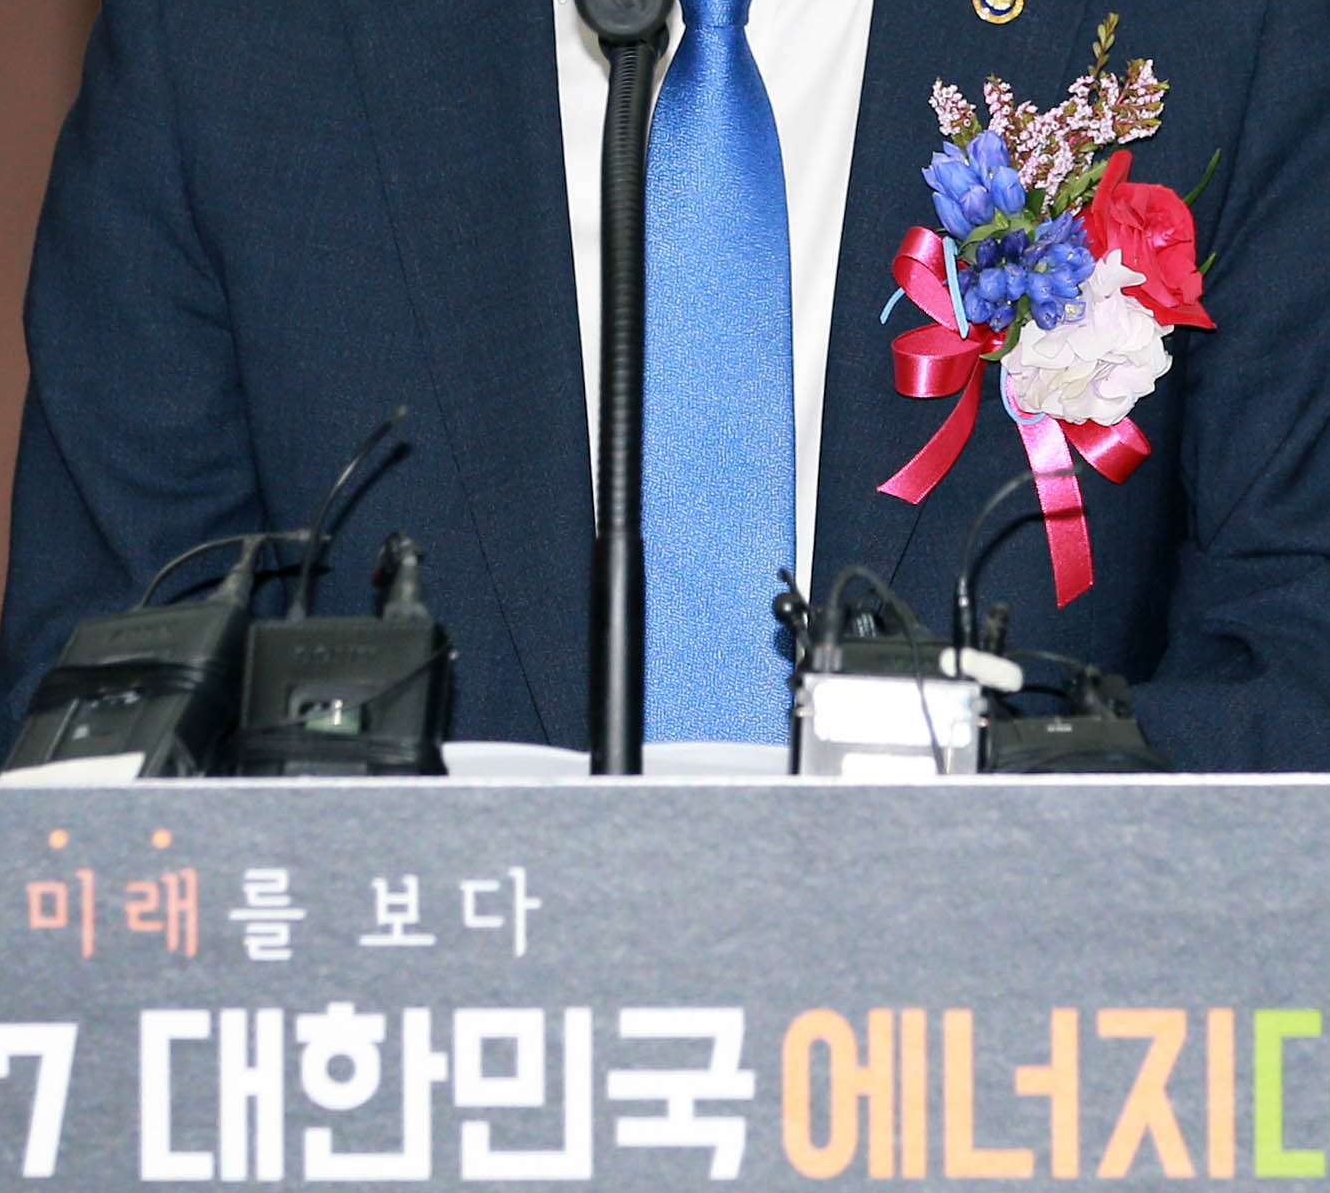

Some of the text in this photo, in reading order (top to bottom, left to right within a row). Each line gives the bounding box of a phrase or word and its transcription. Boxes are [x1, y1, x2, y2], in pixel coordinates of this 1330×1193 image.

[27, 866, 307, 961] 미래를
[357, 865, 544, 959] 보다
[138, 999, 759, 1184] 대한민국
